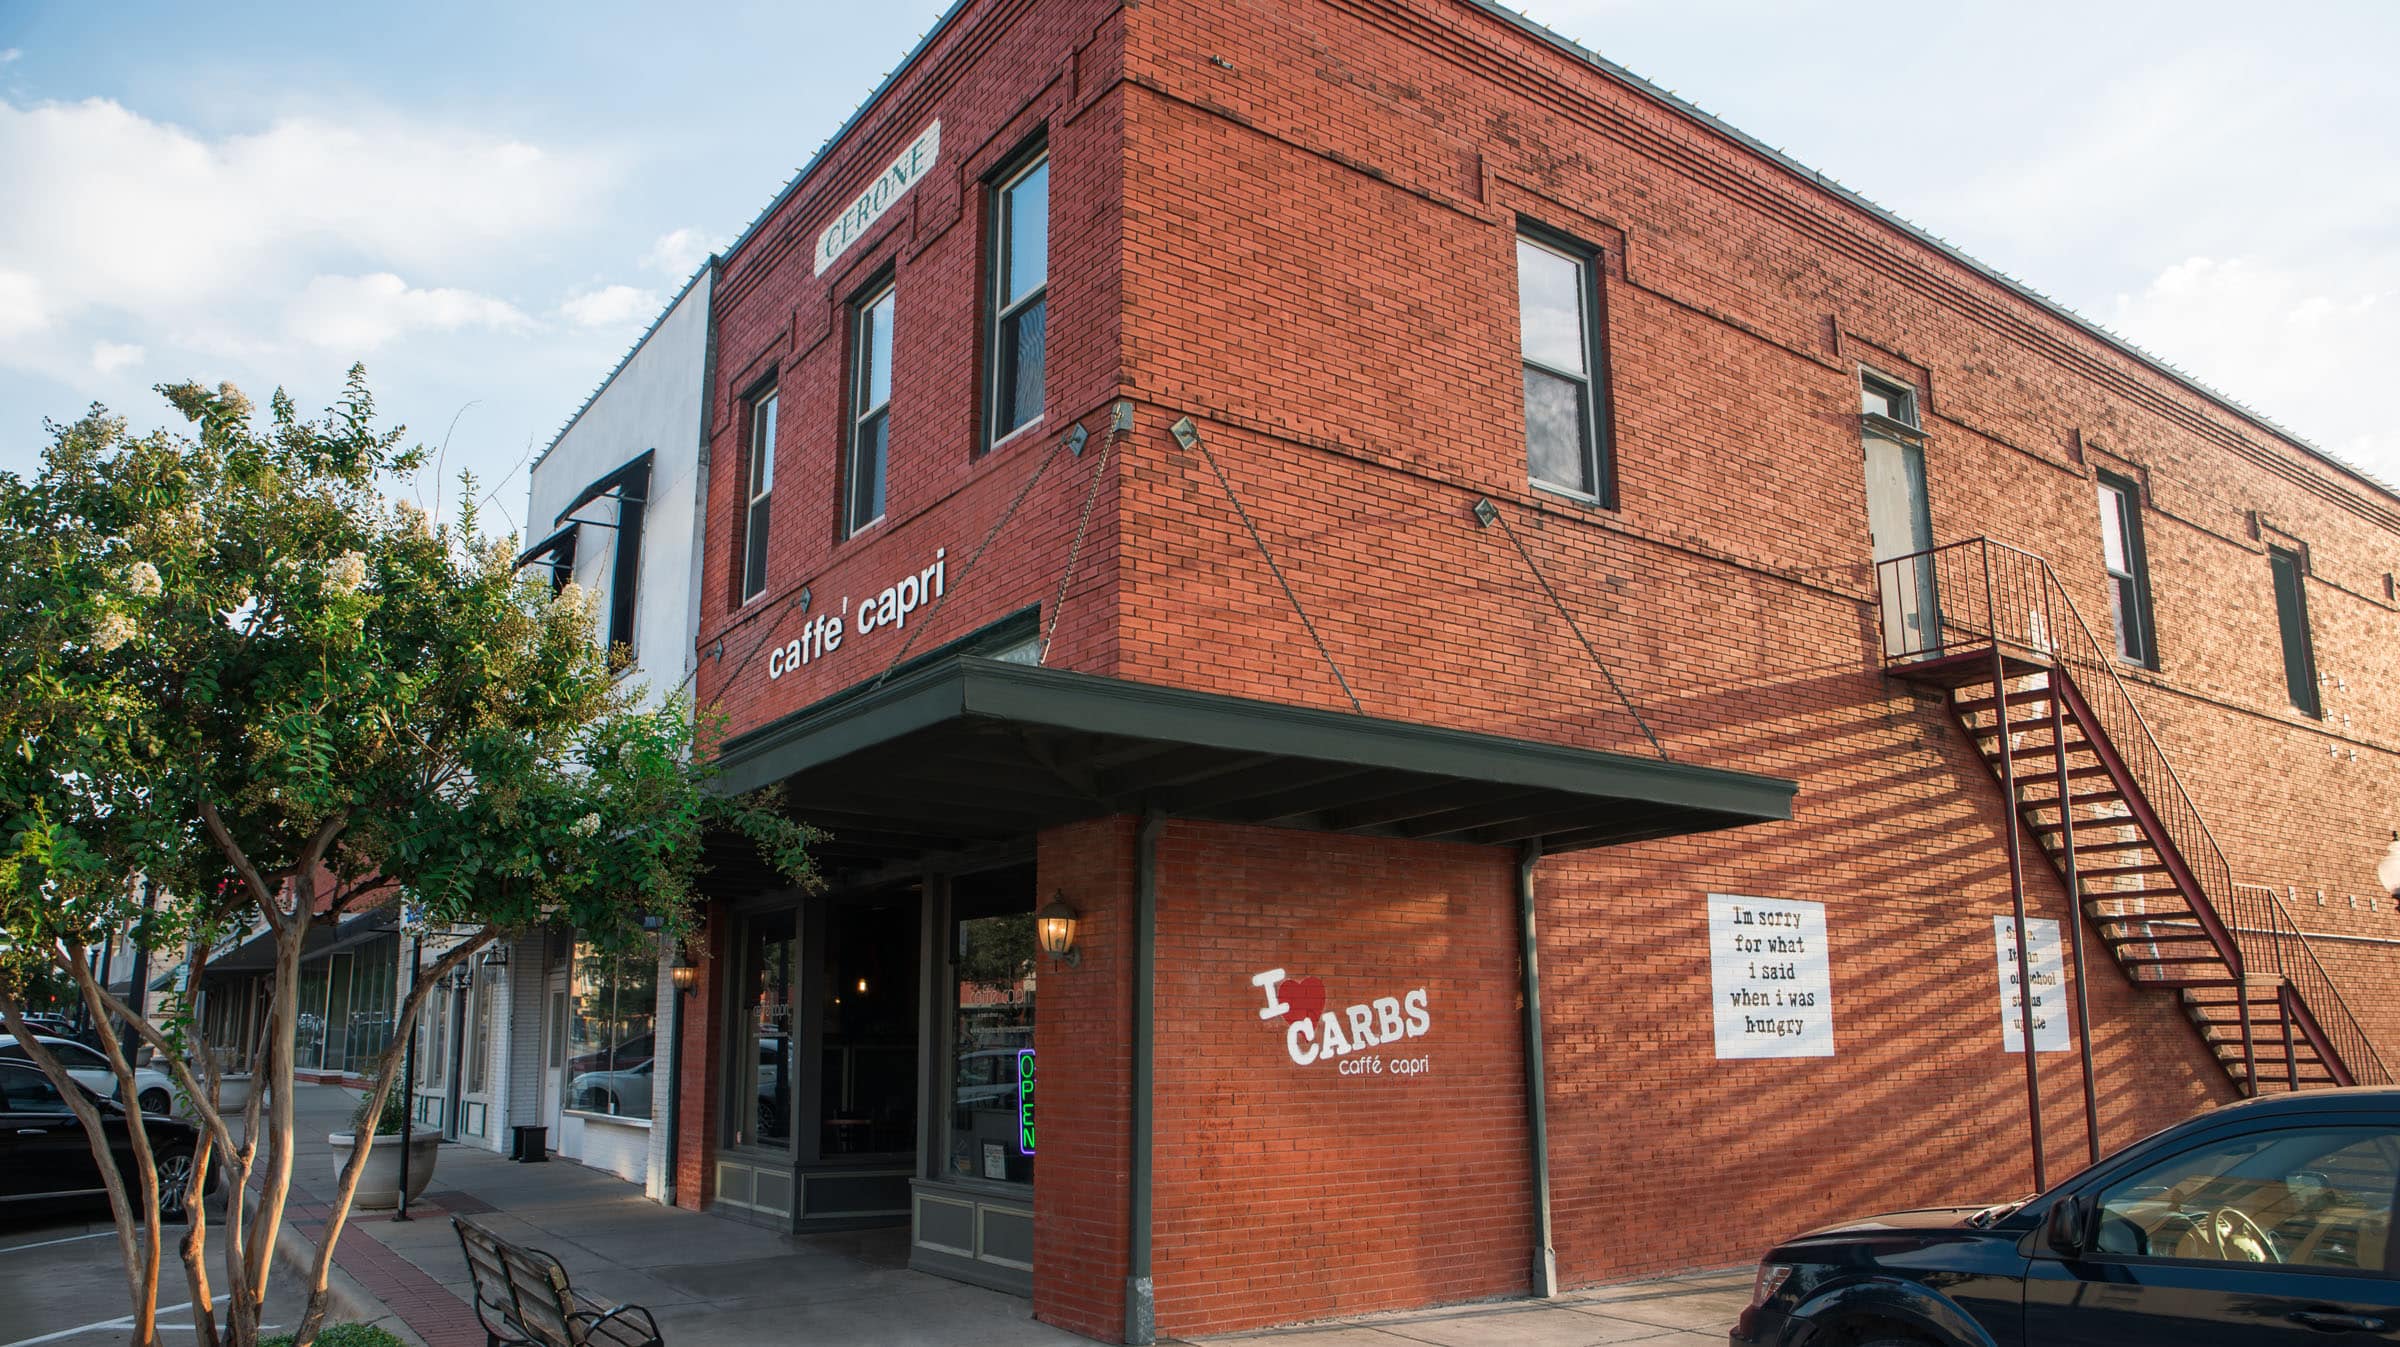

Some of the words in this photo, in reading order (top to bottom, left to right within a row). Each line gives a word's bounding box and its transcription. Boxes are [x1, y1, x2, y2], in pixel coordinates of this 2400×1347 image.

[825, 138, 926, 258] CERONE
[857, 547, 946, 635] capri
[1758, 910, 1801, 929] sorry
[1734, 934, 1762, 952] for
[1768, 936, 1805, 953] what
[1749, 961, 1756, 979] i
[1762, 962, 1796, 980] said
[1252, 968, 1290, 1020] I
[1730, 988, 1770, 1007] when
[1776, 989, 1784, 1006] i
[1788, 992, 1815, 1008] was
[2012, 993, 2042, 1007] stus
[1286, 987, 1431, 1066] CARBS
[1745, 1016, 1804, 1037] hungry
[1338, 1055, 1383, 1075] caffé
[1390, 1054, 1429, 1076] capri
[1020, 1055, 1035, 1149] OPEN
